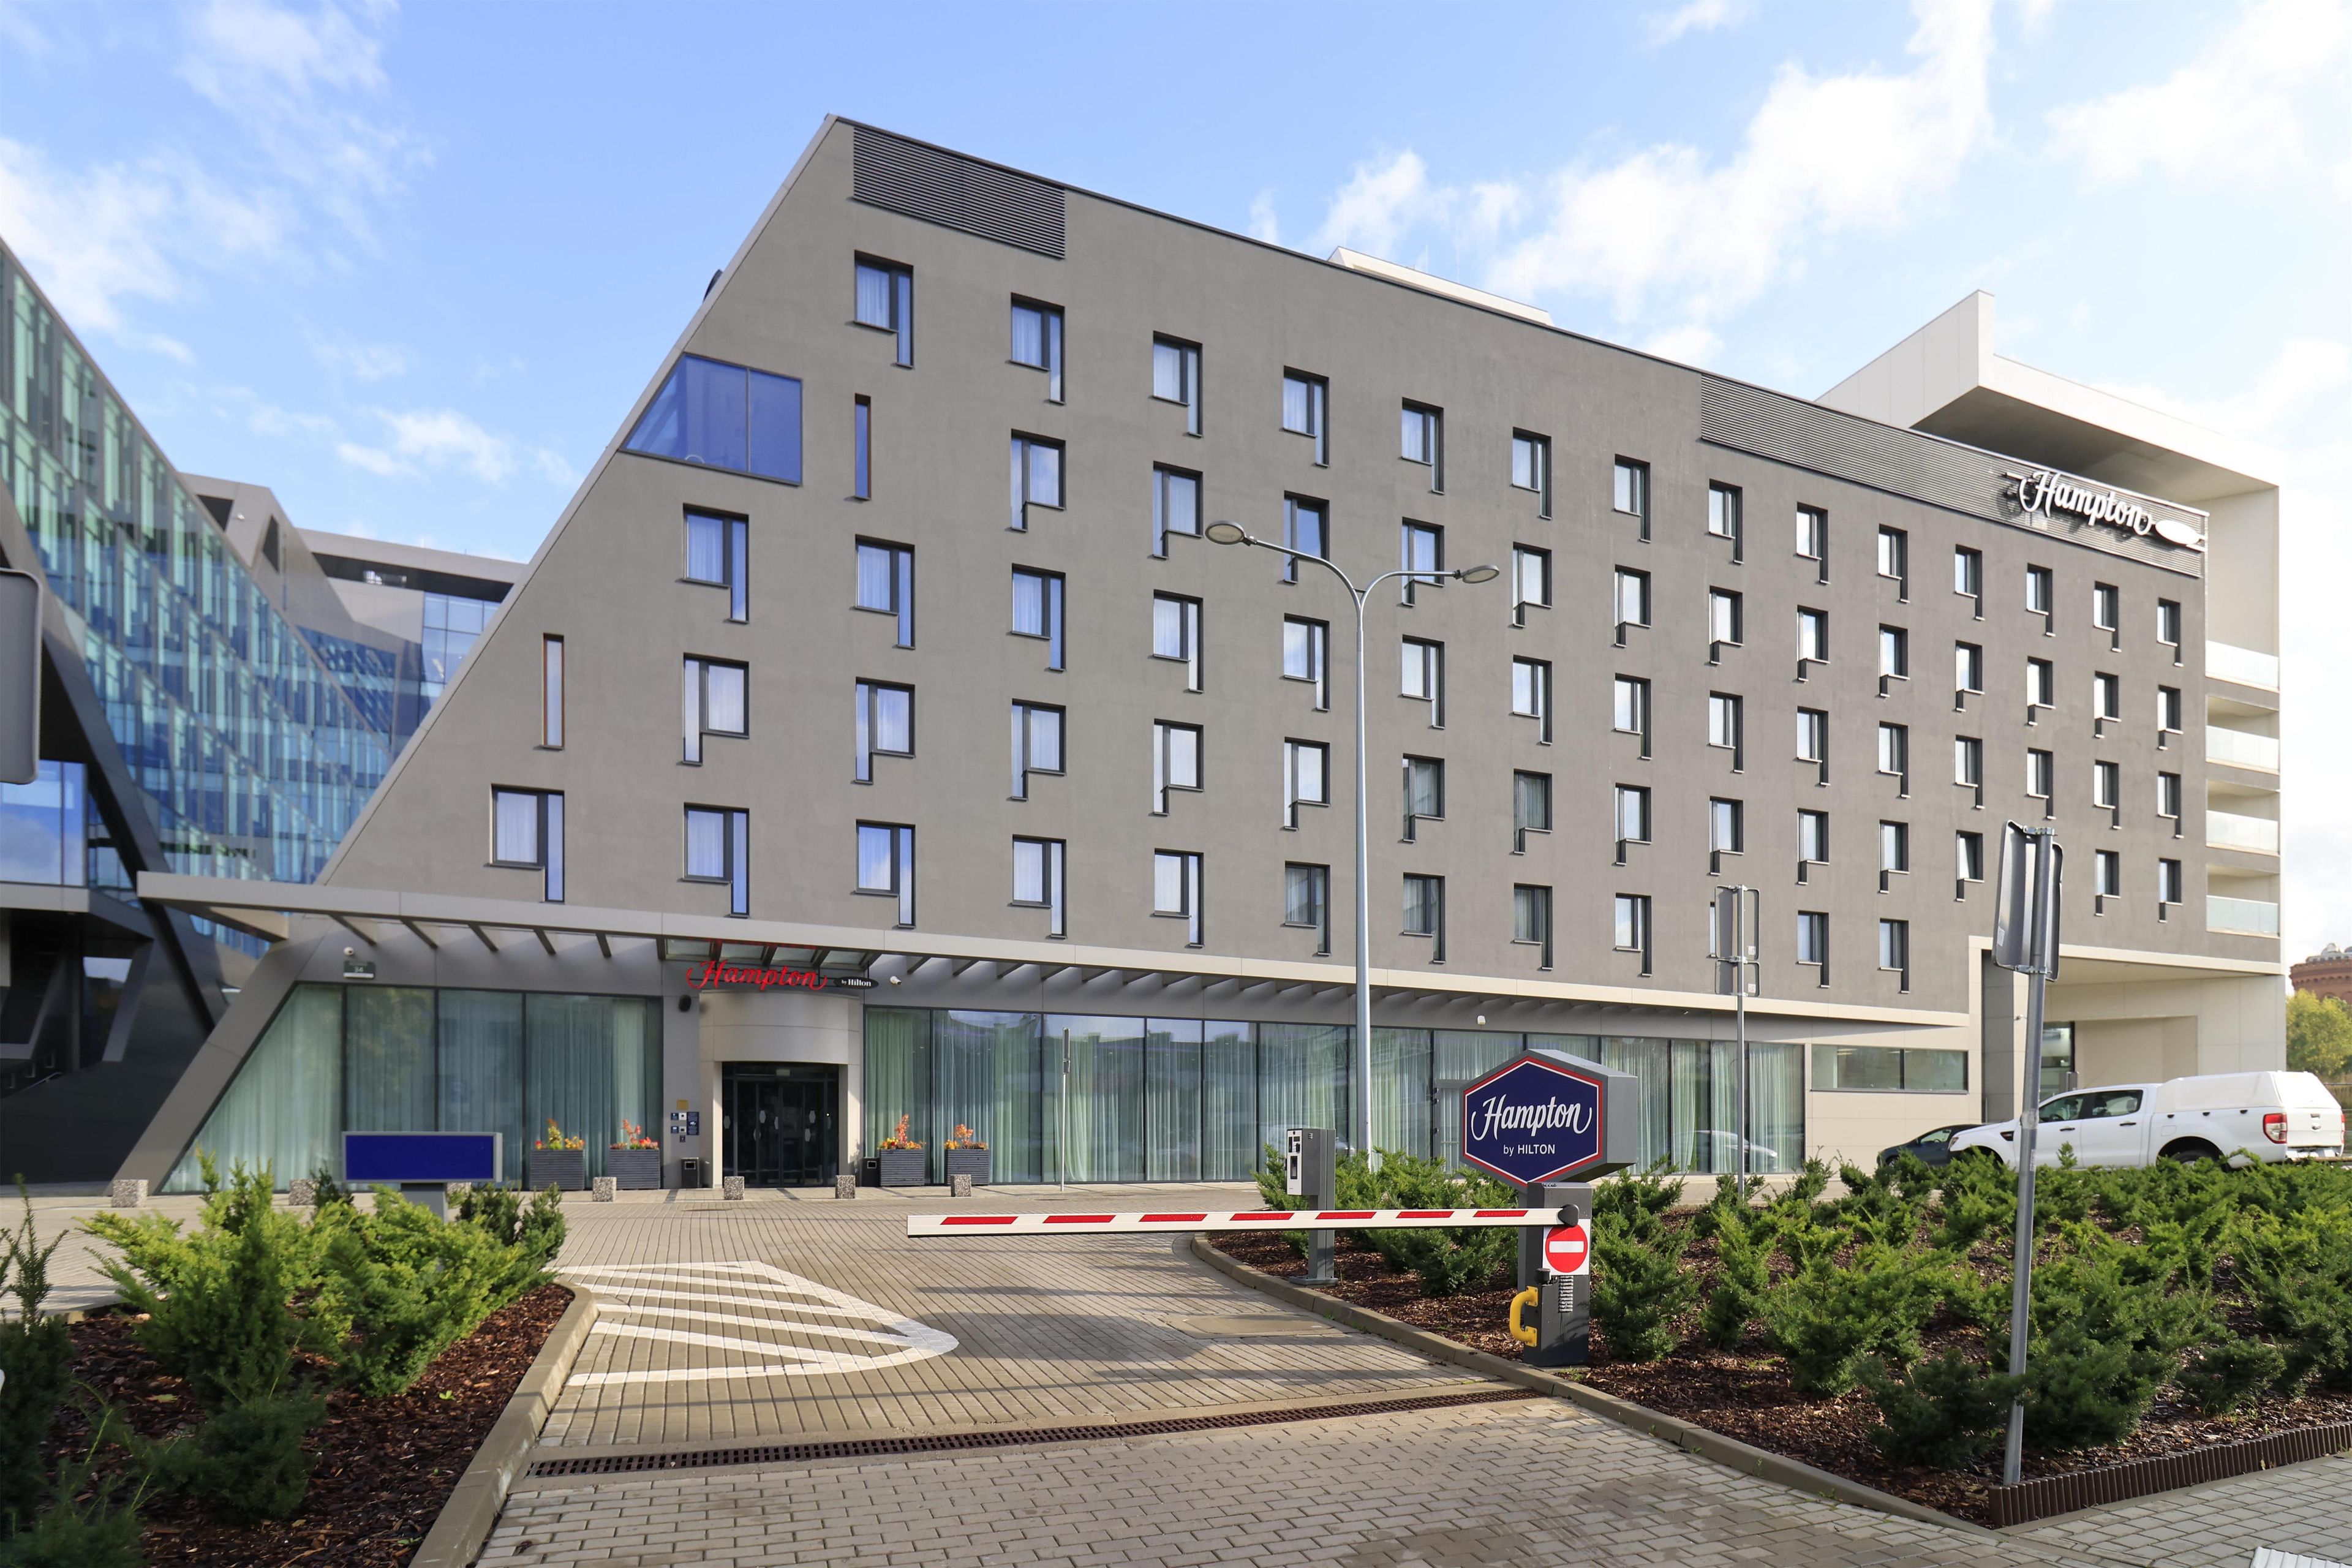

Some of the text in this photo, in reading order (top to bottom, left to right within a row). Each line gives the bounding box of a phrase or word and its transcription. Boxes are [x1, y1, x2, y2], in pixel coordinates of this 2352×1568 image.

[2019, 471, 2152, 535] Hampton
[687, 959, 827, 990] Hampton
[1471, 1095, 1593, 1141] Hampton
[1503, 1144, 1555, 1156] by HILTON
